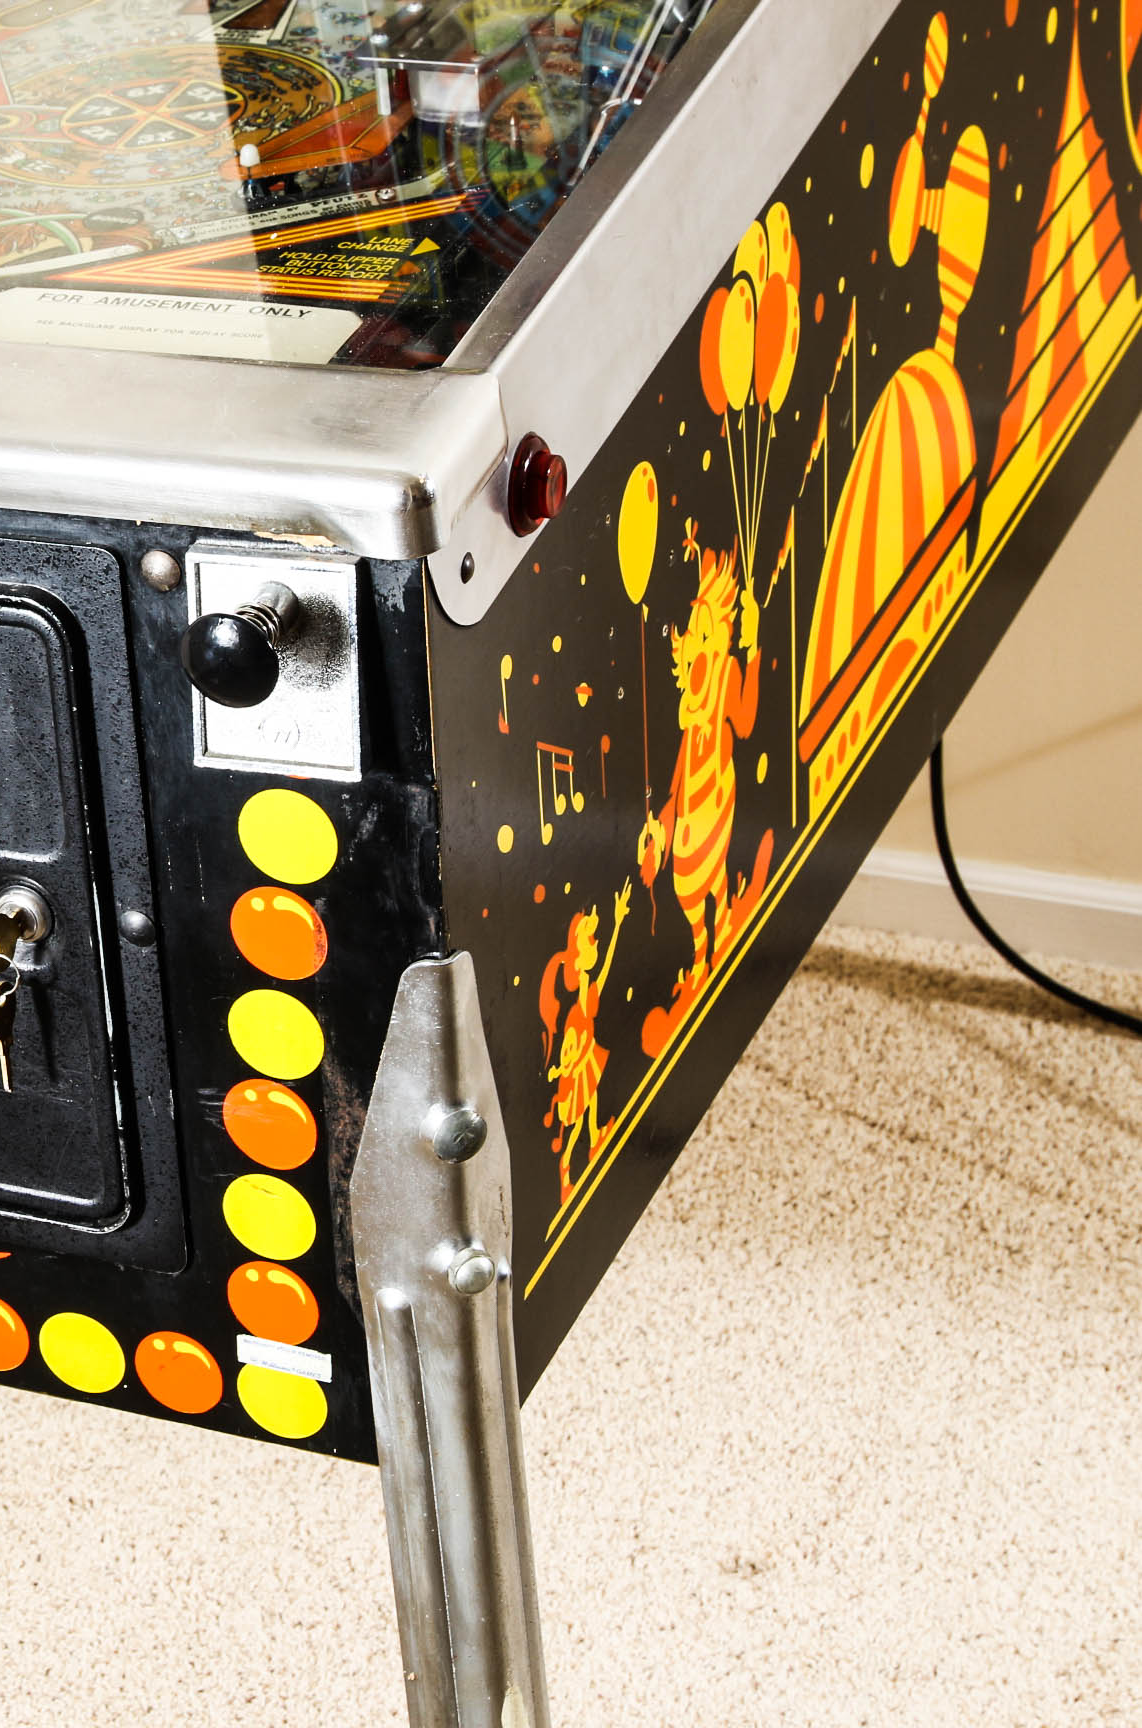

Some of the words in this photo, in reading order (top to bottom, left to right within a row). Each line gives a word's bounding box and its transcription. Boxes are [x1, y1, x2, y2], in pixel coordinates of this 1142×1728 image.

[337, 241, 409, 253] CHANGE
[369, 236, 414, 246] LANE
[279, 251, 327, 261] HOLD
[328, 253, 400, 265] FLIPPER
[255, 265, 324, 278] STATUS
[324, 268, 387, 280] REPORT
[286, 259, 354, 271] BUTTON
[355, 263, 393, 273] FOR
[36, 292, 85, 304] FOR
[97, 295, 235, 314] AMUSEMENT
[248, 304, 313, 319] ONLY
